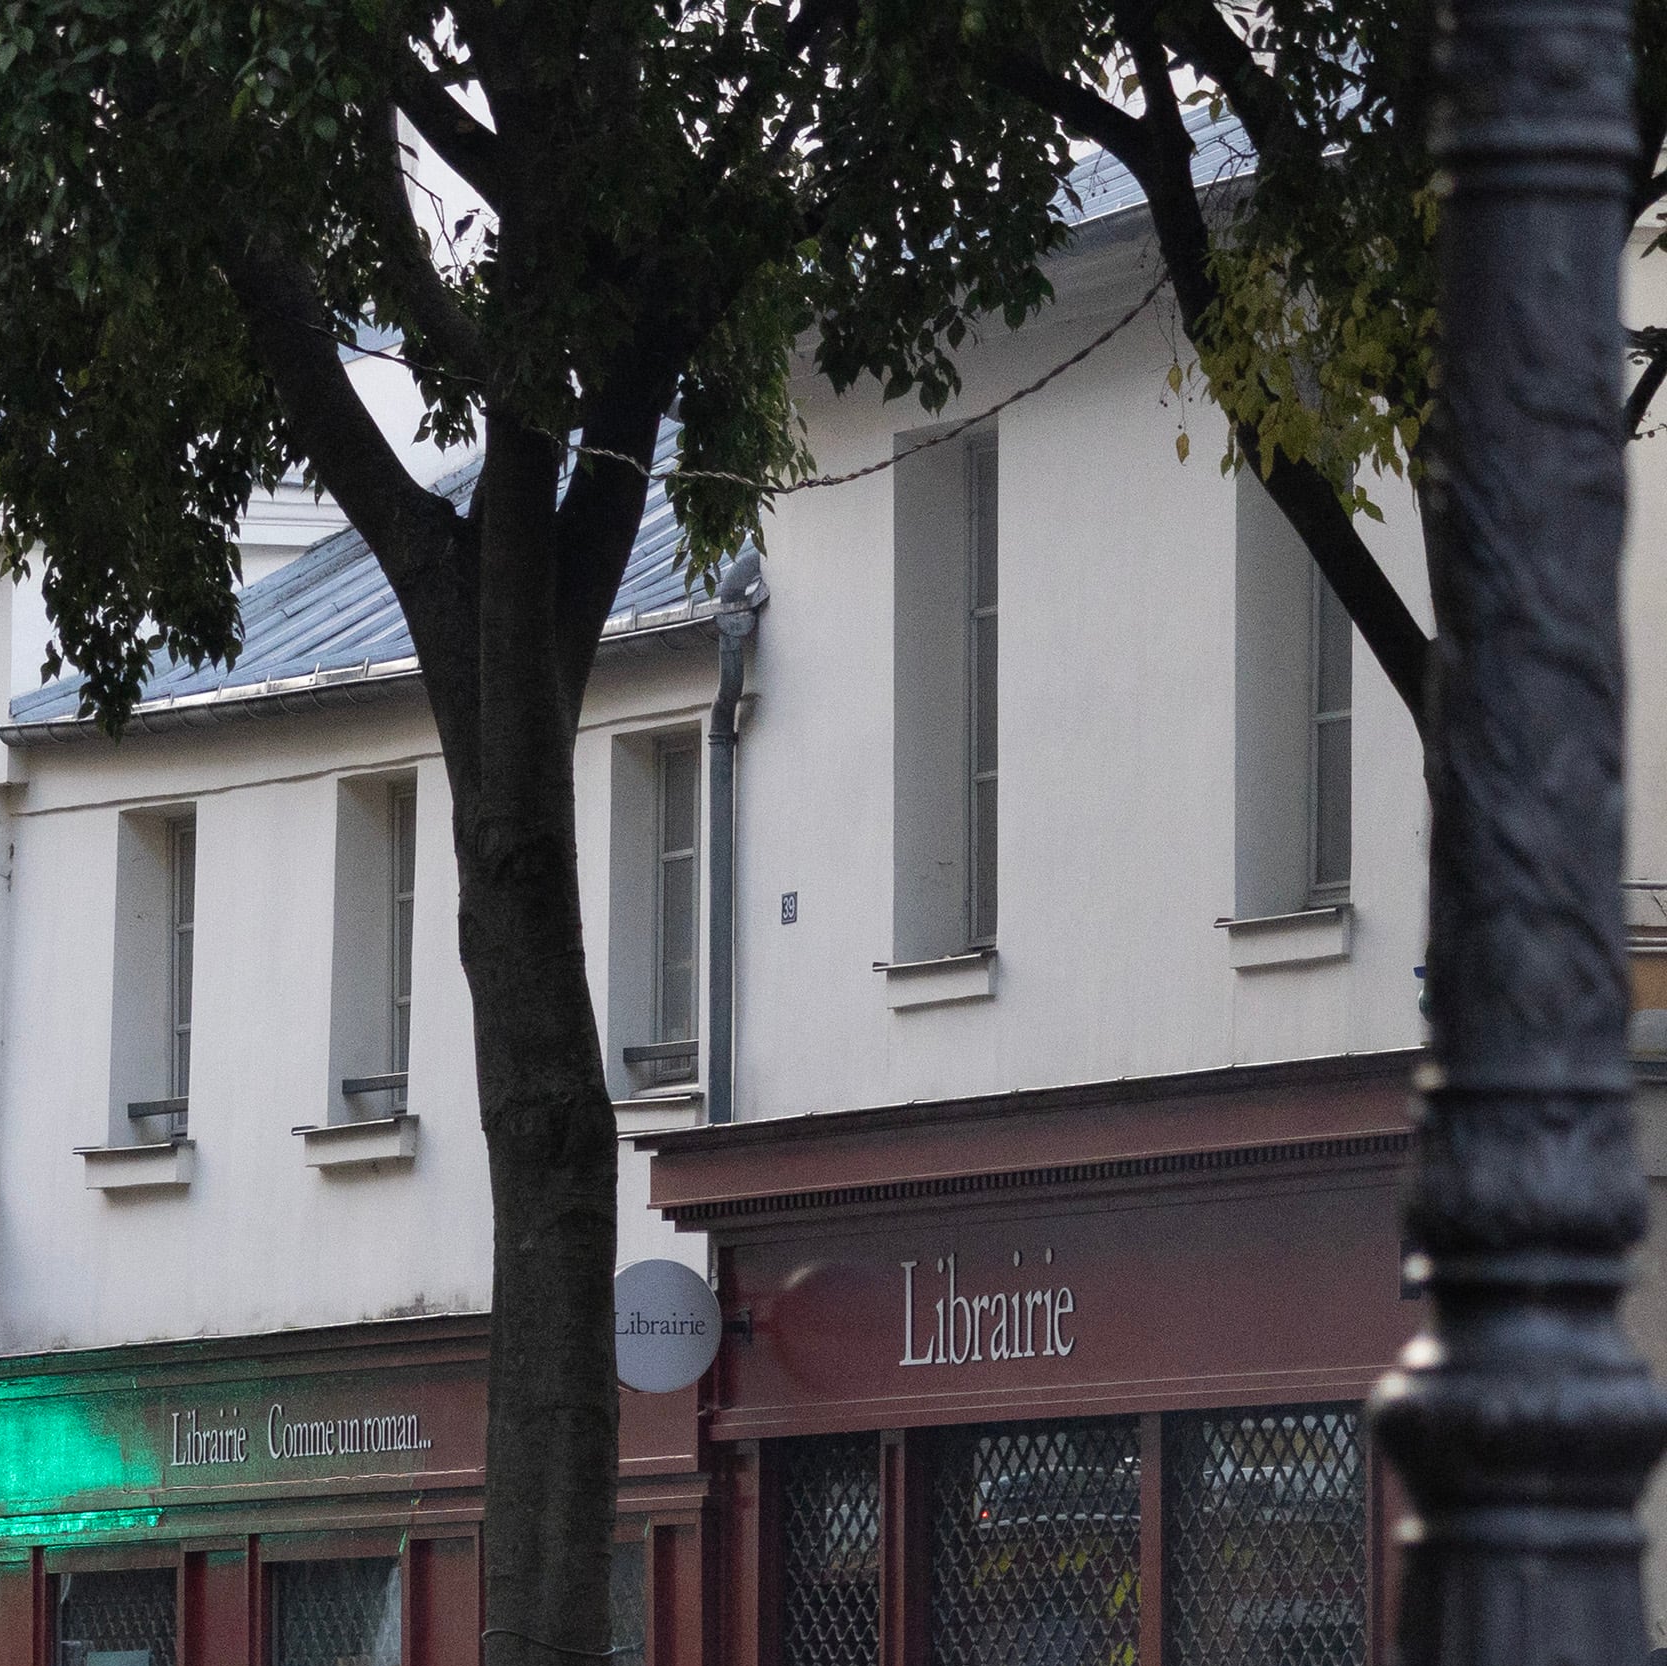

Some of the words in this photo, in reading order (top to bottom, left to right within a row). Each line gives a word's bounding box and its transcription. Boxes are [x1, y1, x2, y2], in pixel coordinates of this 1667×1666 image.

[615, 1311, 706, 1337] Librairie
[899, 1247, 1074, 1367] Librairie
[171, 1407, 247, 1467] Librairie
[268, 1404, 334, 1459] Comme
[338, 1418, 361, 1454] un
